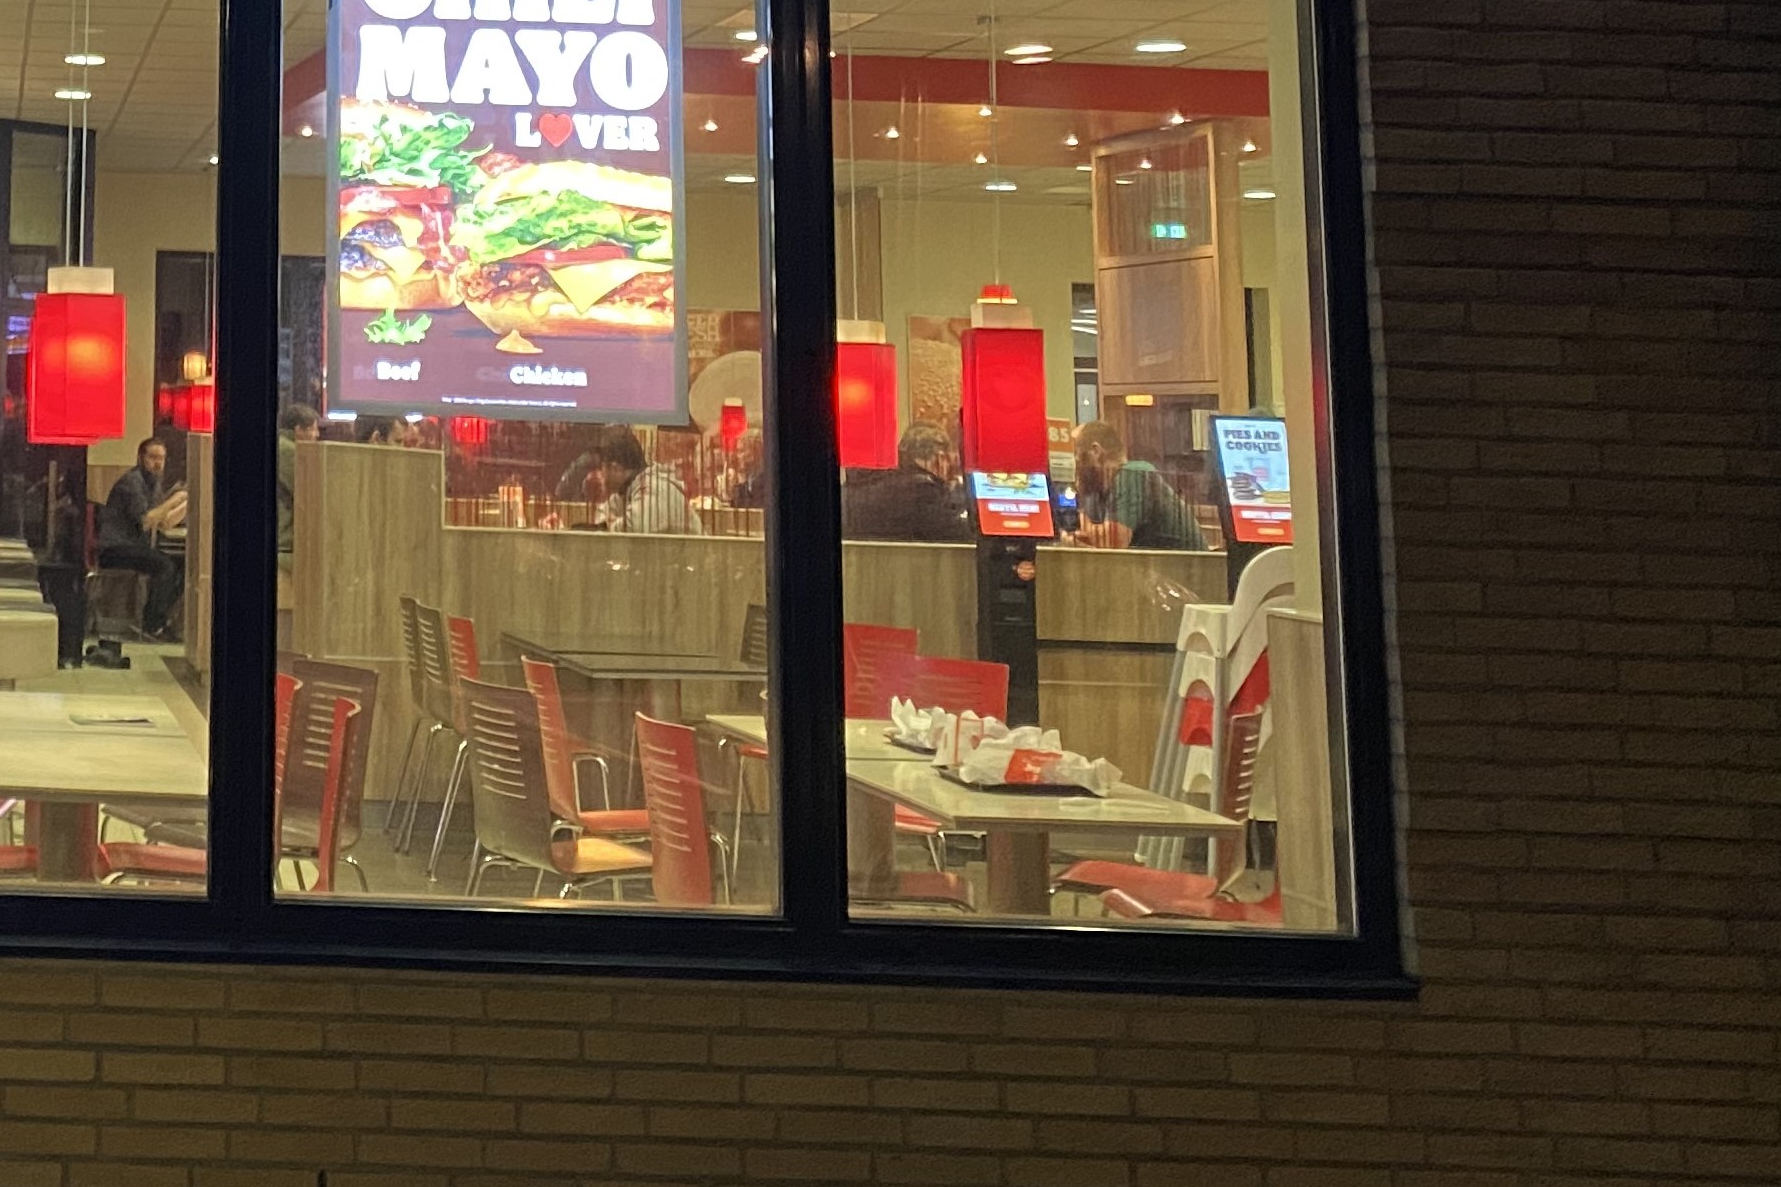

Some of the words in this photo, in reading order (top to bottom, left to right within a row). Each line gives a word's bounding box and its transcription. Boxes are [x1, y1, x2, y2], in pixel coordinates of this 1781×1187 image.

[355, 24, 670, 111] MAYO
[376, 359, 421, 381] Beef
[509, 364, 588, 387] Chicken
[1254, 429, 1281, 441] AND
[1225, 440, 1283, 455] COOKIES
